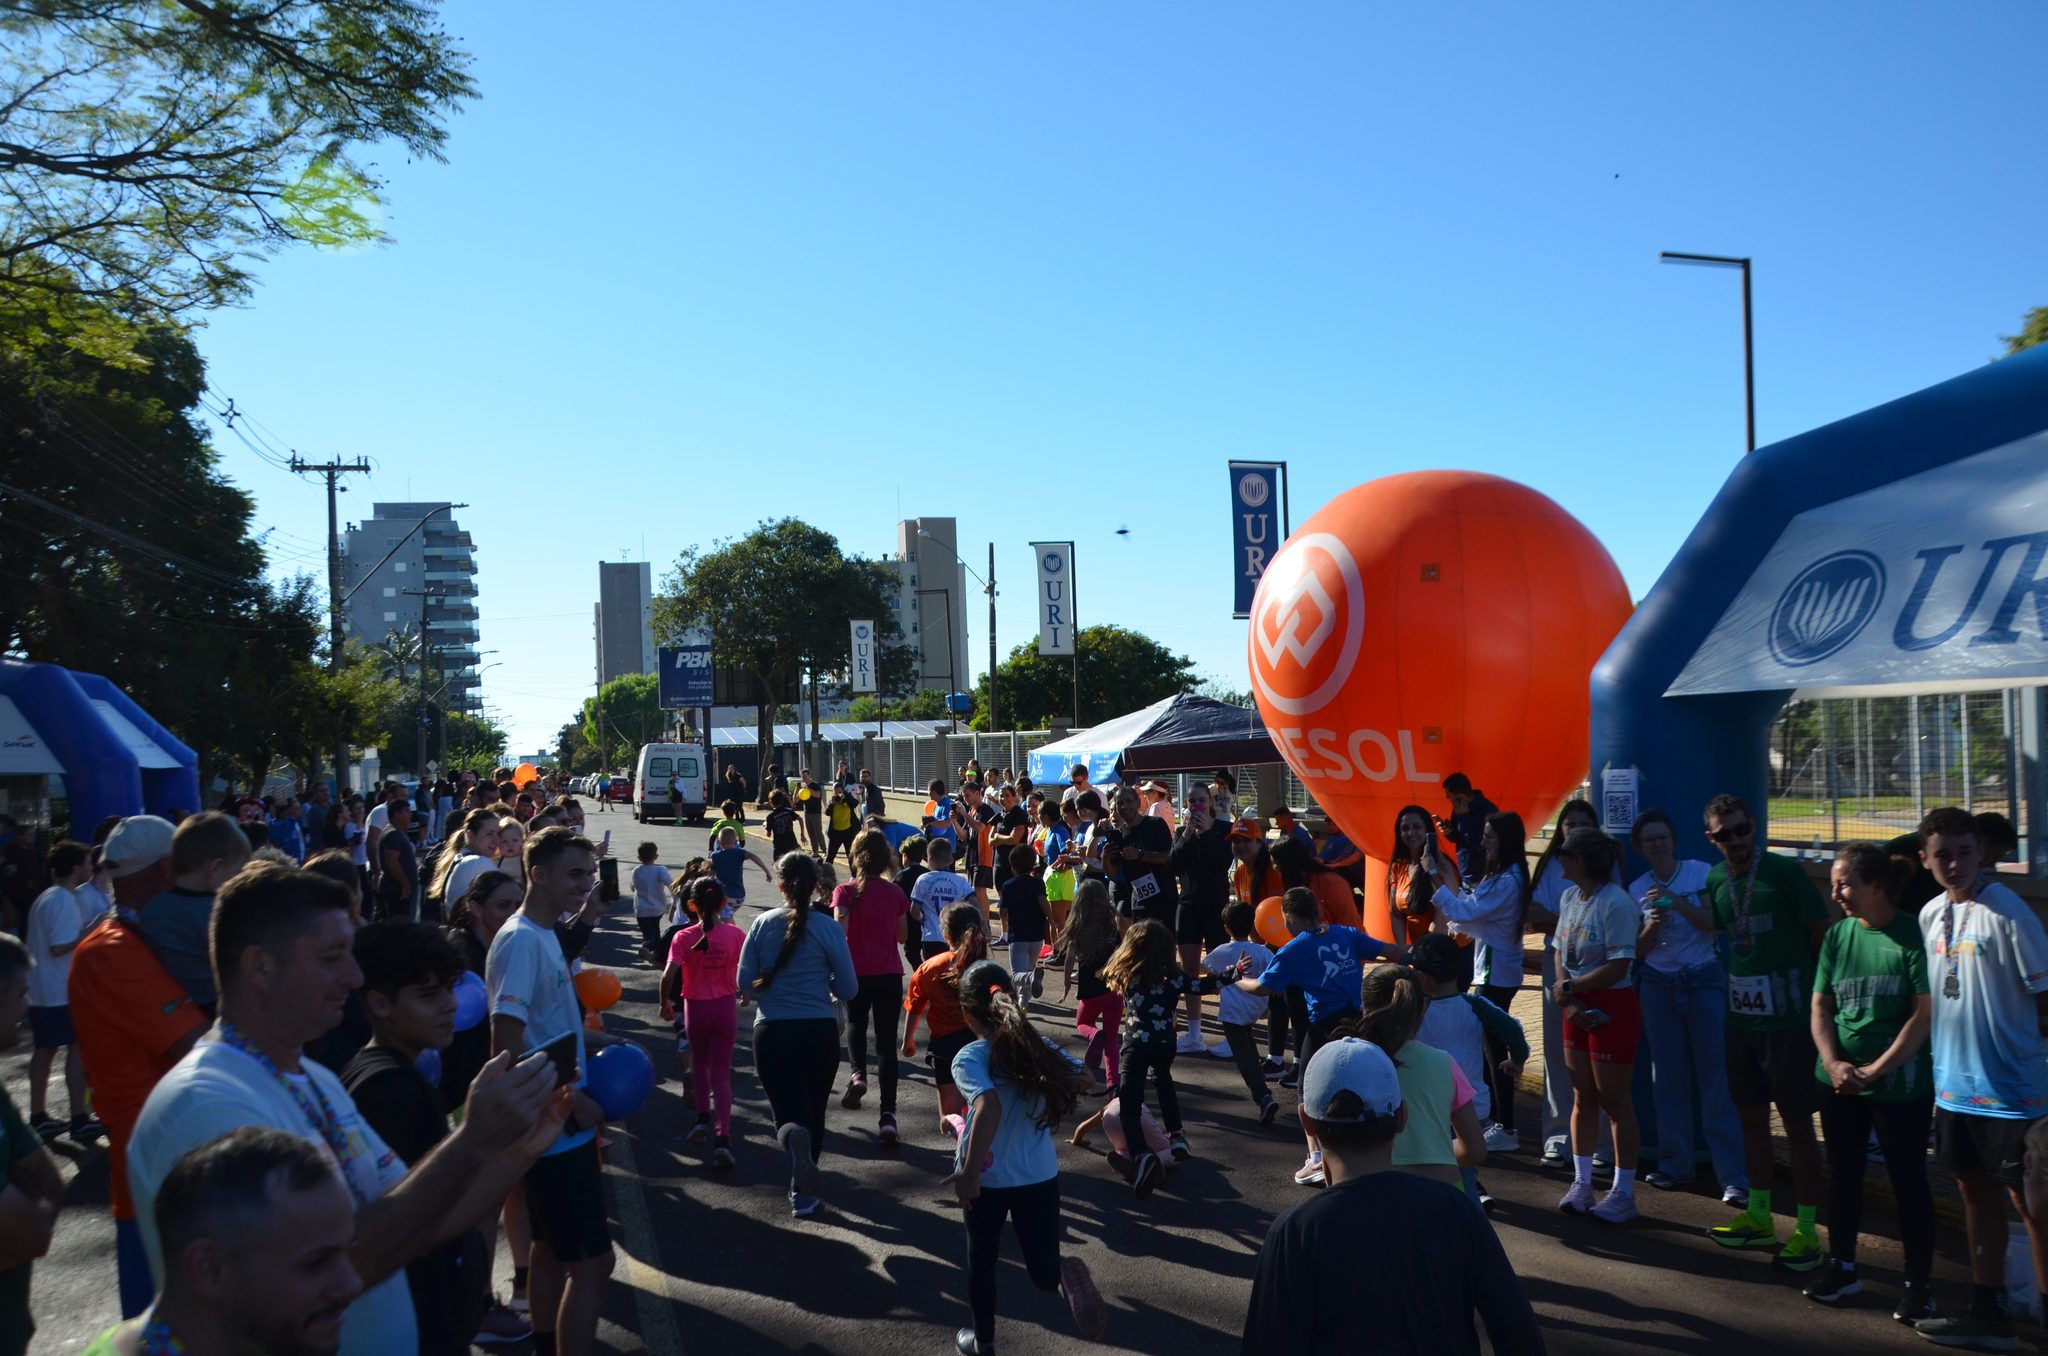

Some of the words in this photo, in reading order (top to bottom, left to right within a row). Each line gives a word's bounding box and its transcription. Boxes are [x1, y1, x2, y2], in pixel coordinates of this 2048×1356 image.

[1045, 581, 1064, 648] URI
[856, 643, 870, 687] URI
[1136, 882, 1156, 899] 859
[1732, 989, 1767, 1012] 644
